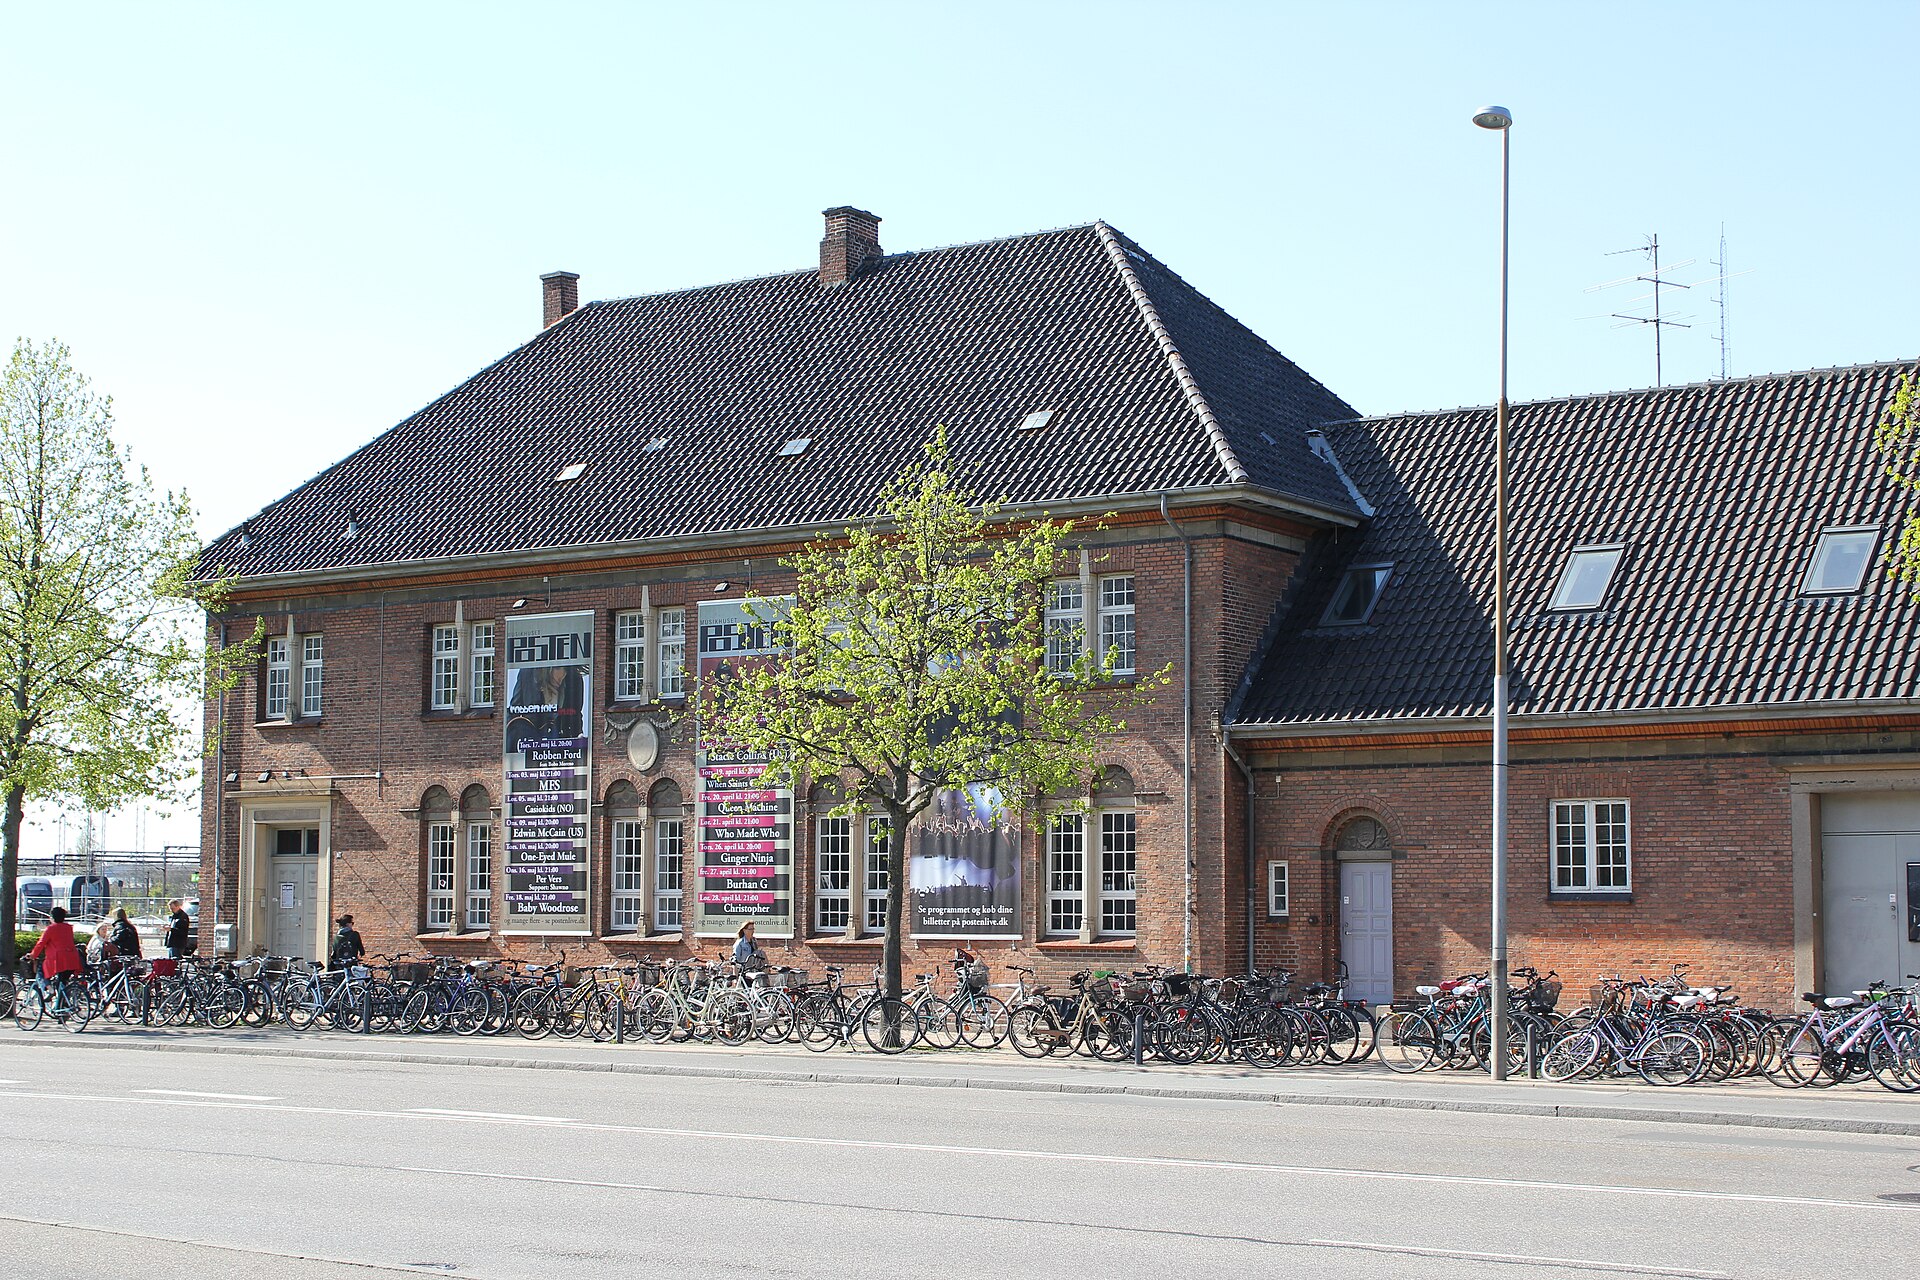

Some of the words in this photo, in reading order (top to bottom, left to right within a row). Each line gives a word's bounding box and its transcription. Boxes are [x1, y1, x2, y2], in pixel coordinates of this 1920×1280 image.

[507, 630, 541, 638] USIKHUSET
[507, 632, 591, 663] POSTEN
[540, 741, 550, 749] maj
[532, 750, 561, 760] Robben
[564, 749, 581, 759] Ford
[737, 750, 767, 761] Collins
[530, 771, 539, 779] maj
[725, 768, 738, 777] april
[539, 780, 560, 791] MFS
[707, 780, 727, 788] When
[527, 795, 536, 803] maj
[722, 793, 735, 802] april
[525, 804, 556, 813] Casiokids
[557, 804, 574, 813] (NO)
[718, 802, 743, 814] Queen
[745, 802, 778, 812] Machine
[722, 818, 735, 827] april
[513, 828, 535, 838] Edwin
[538, 828, 566, 837] McCain
[568, 827, 584, 837] (US)
[715, 828, 735, 838] Who
[737, 828, 759, 838] Made
[760, 828, 780, 838] Who
[724, 844, 736, 852] april
[521, 851, 556, 864] One-Eyed
[557, 851, 576, 860] Mule
[721, 853, 749, 865] Ginger
[751, 853, 774, 865] Ninja
[527, 867, 537, 875] maj
[720, 868, 732, 877] april
[536, 875, 547, 883] Per
[547, 875, 562, 883] Vers
[726, 879, 757, 889] Burhan
[760, 879, 768, 889] G
[524, 894, 534, 902] maj
[722, 894, 734, 903] april
[518, 902, 537, 915] Baby
[539, 902, 579, 912] Woodrose
[724, 903, 770, 915] Christopher
[918, 905, 926, 913] Se
[928, 906, 970, 916] programmet
[971, 907, 981, 916] og
[997, 905, 1014, 913] dine
[754, 918, 788, 926] ostenlive.dk
[923, 917, 950, 926] billetter
[951, 917, 961, 928] på
[961, 917, 1008, 928] postenlive.dk
